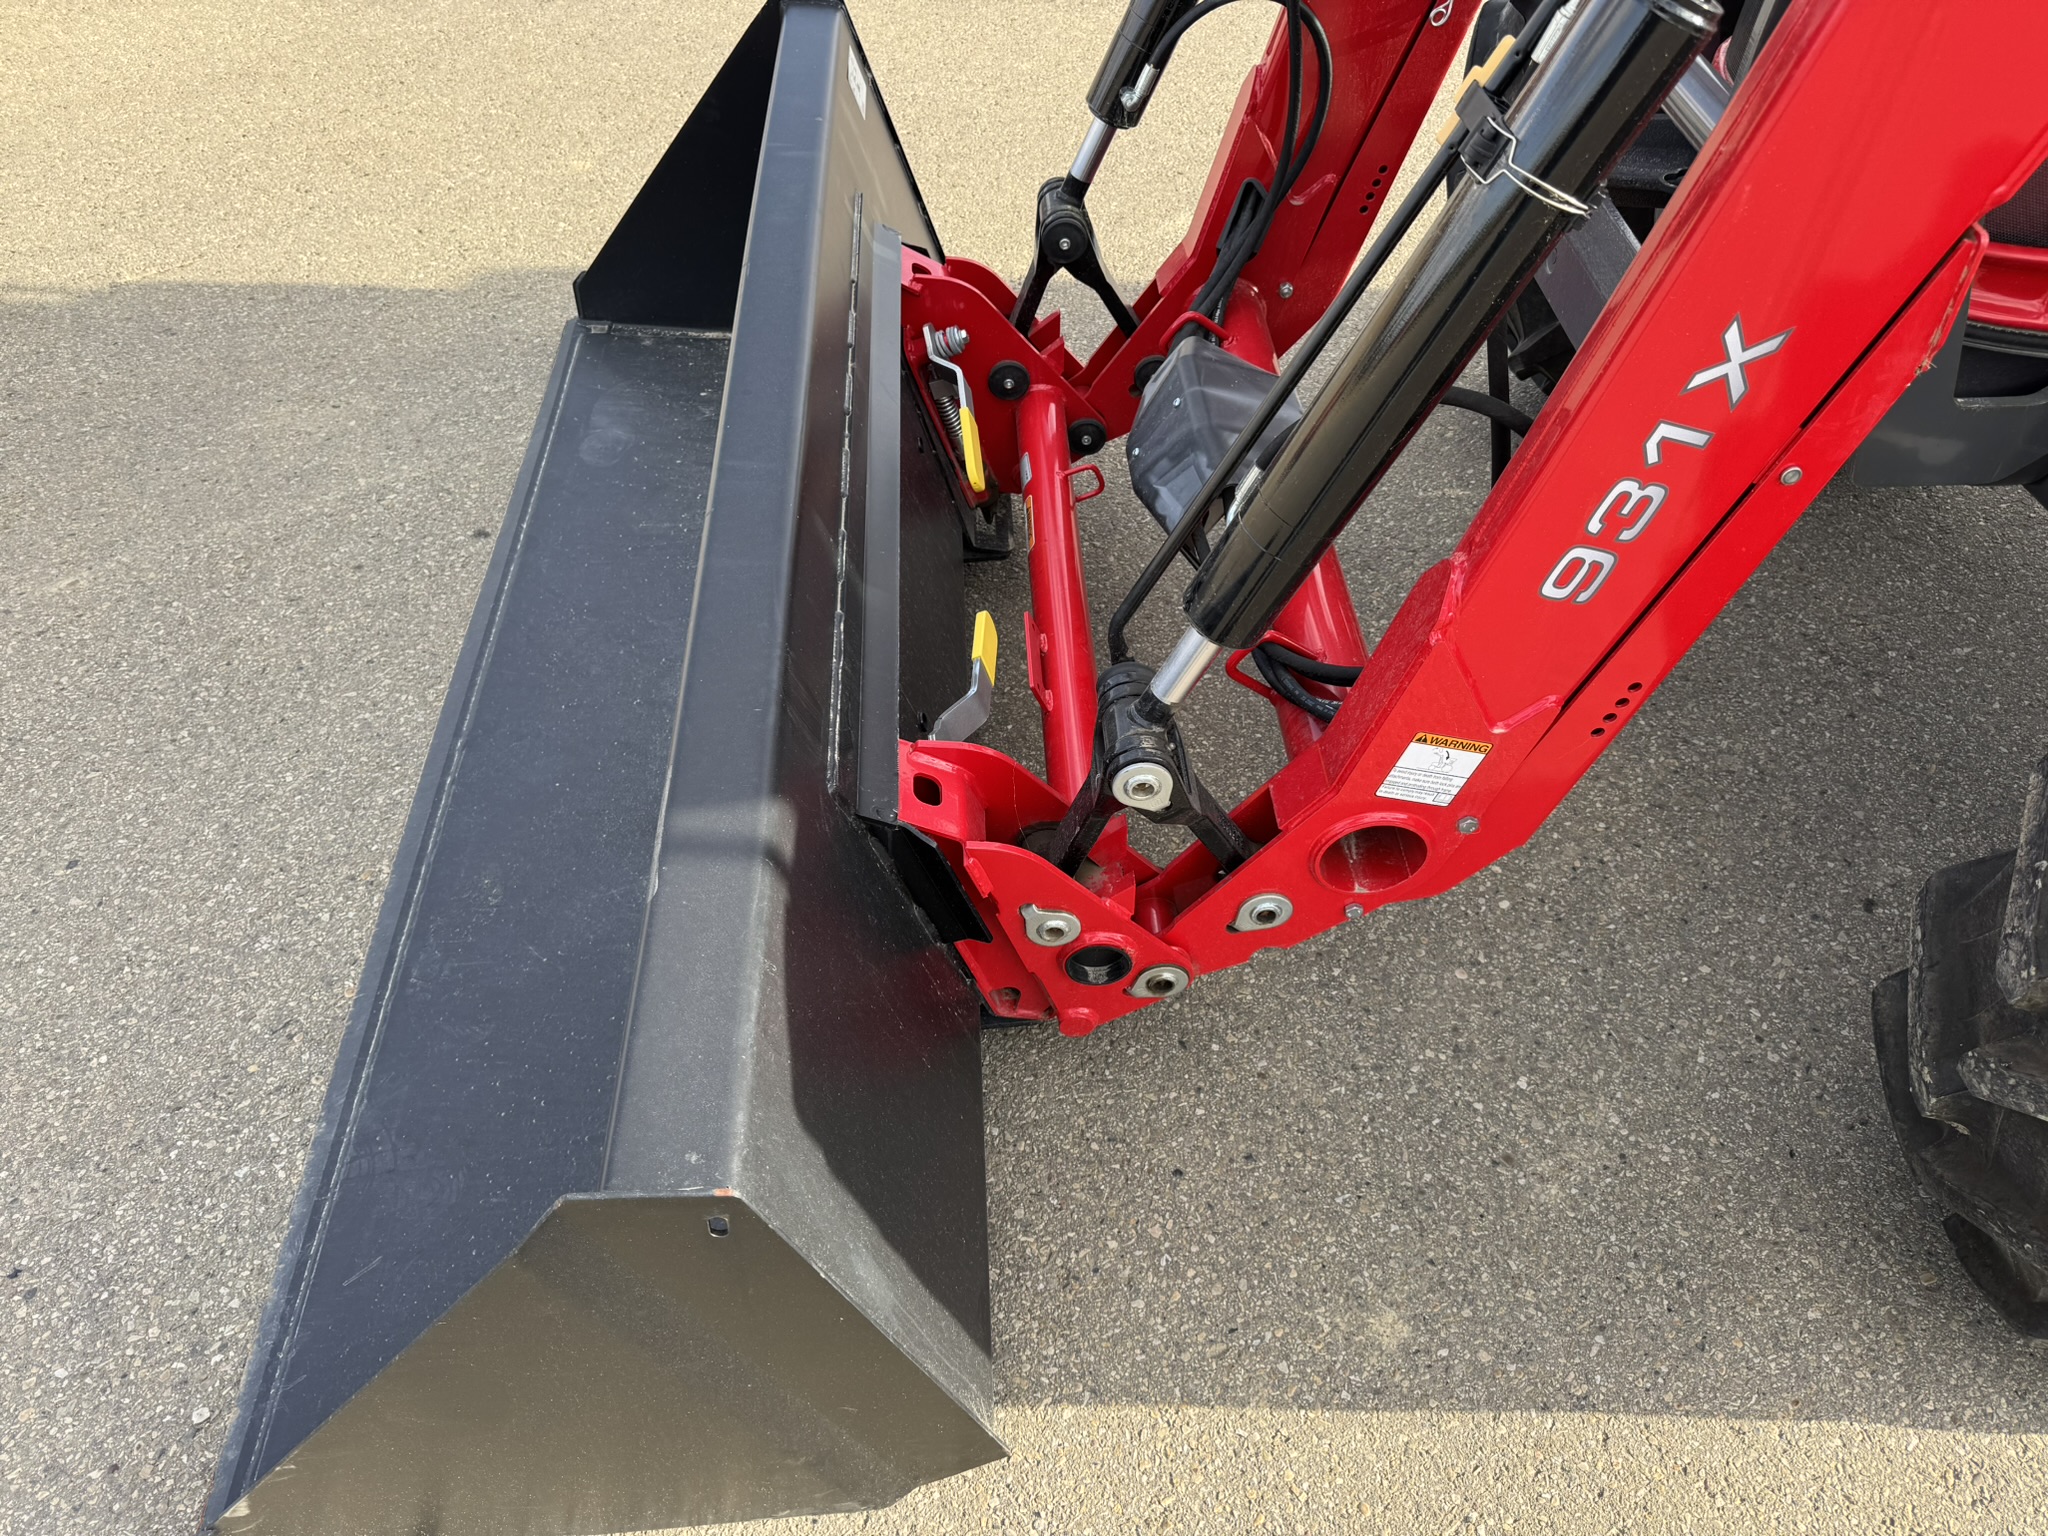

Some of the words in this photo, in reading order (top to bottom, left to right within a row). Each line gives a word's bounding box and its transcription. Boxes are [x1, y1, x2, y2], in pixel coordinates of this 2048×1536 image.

[1539, 419, 1716, 604] 931
[1679, 311, 1797, 413] X
[1429, 736, 1490, 753] WARNING
